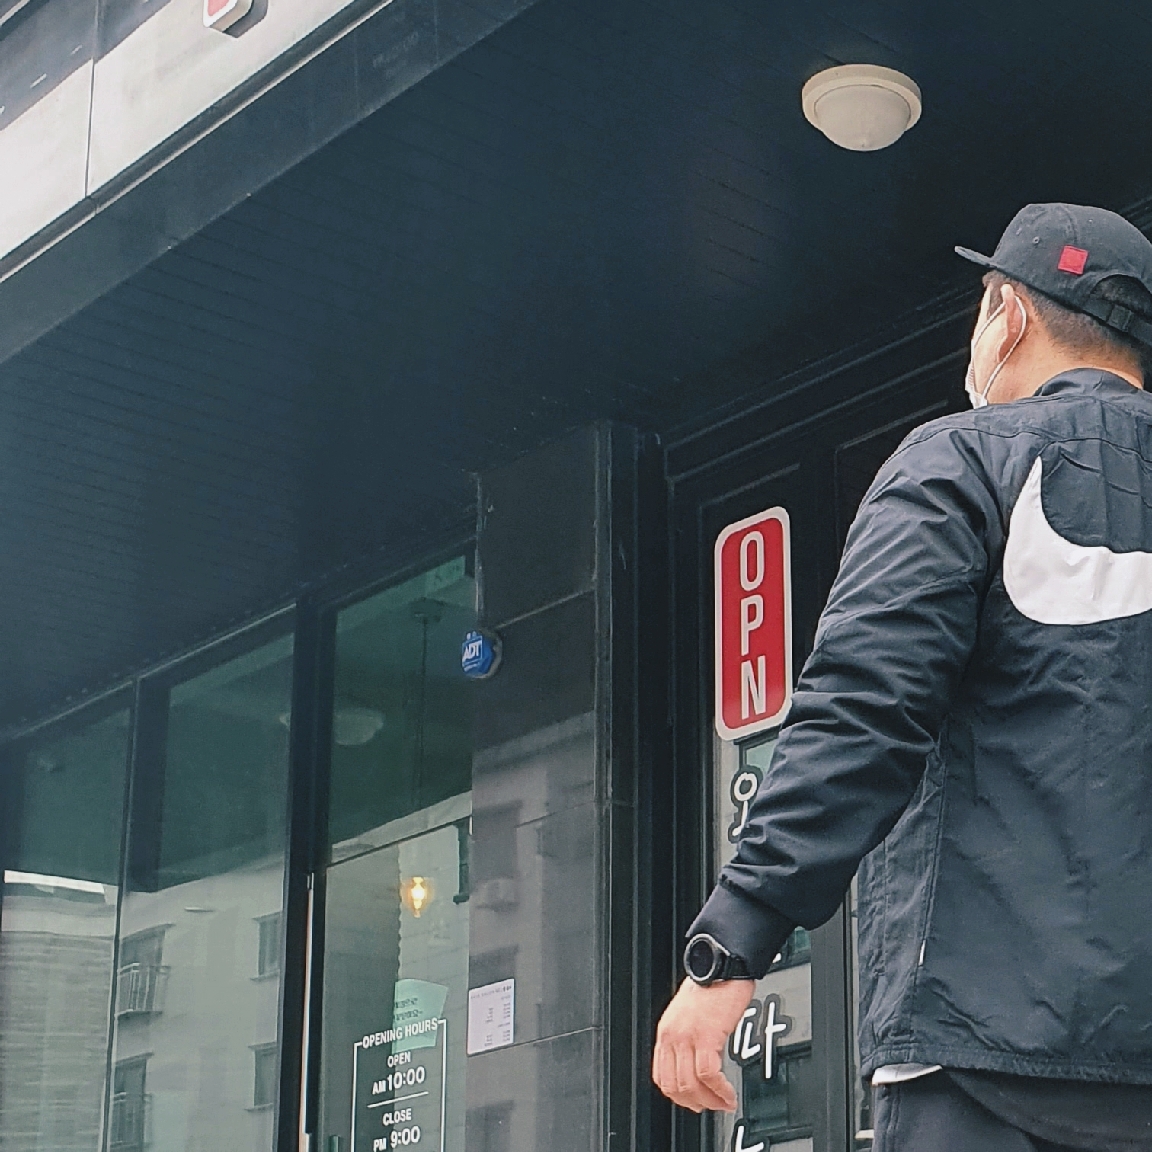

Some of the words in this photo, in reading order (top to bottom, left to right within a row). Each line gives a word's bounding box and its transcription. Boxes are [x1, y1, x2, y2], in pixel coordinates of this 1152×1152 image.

[739, 530, 767, 720] OPN
[362, 1026, 403, 1049] OPENING
[404, 1017, 438, 1037] HOURS
[387, 1051, 411, 1068] OPEN
[372, 1079, 387, 1095] AM
[387, 1066, 426, 1091] 10:00
[382, 1108, 412, 1126] CLOSE
[373, 1137, 387, 1152] PM
[390, 1126, 421, 1148] 9:00
